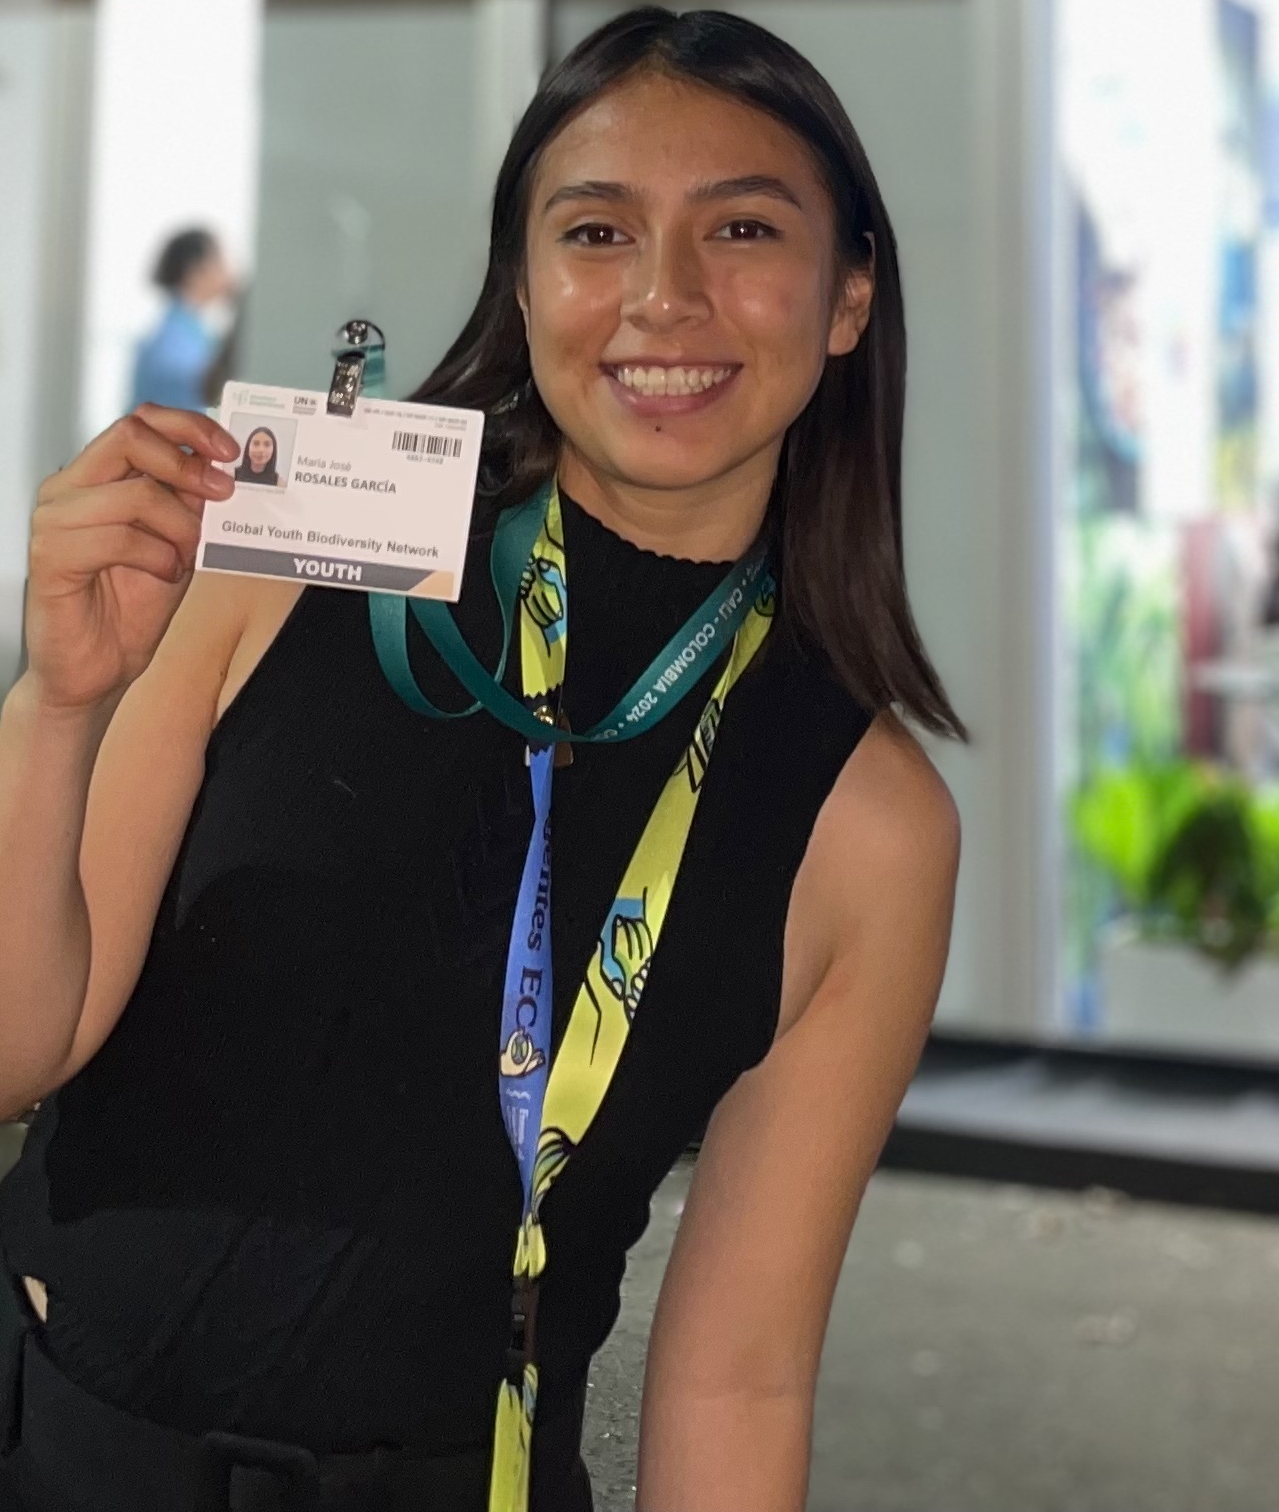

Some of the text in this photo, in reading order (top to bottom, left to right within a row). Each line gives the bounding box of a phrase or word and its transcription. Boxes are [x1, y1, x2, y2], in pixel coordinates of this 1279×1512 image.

[294, 471, 397, 494] ROSALES GARCÍA
[222, 520, 439, 558] Global Youth Biodiversity Network
[293, 557, 362, 581] YOUTH
[719, 588, 743, 620] CALI
[652, 623, 716, 693] COLOMBIA
[625, 691, 658, 723] 2024
